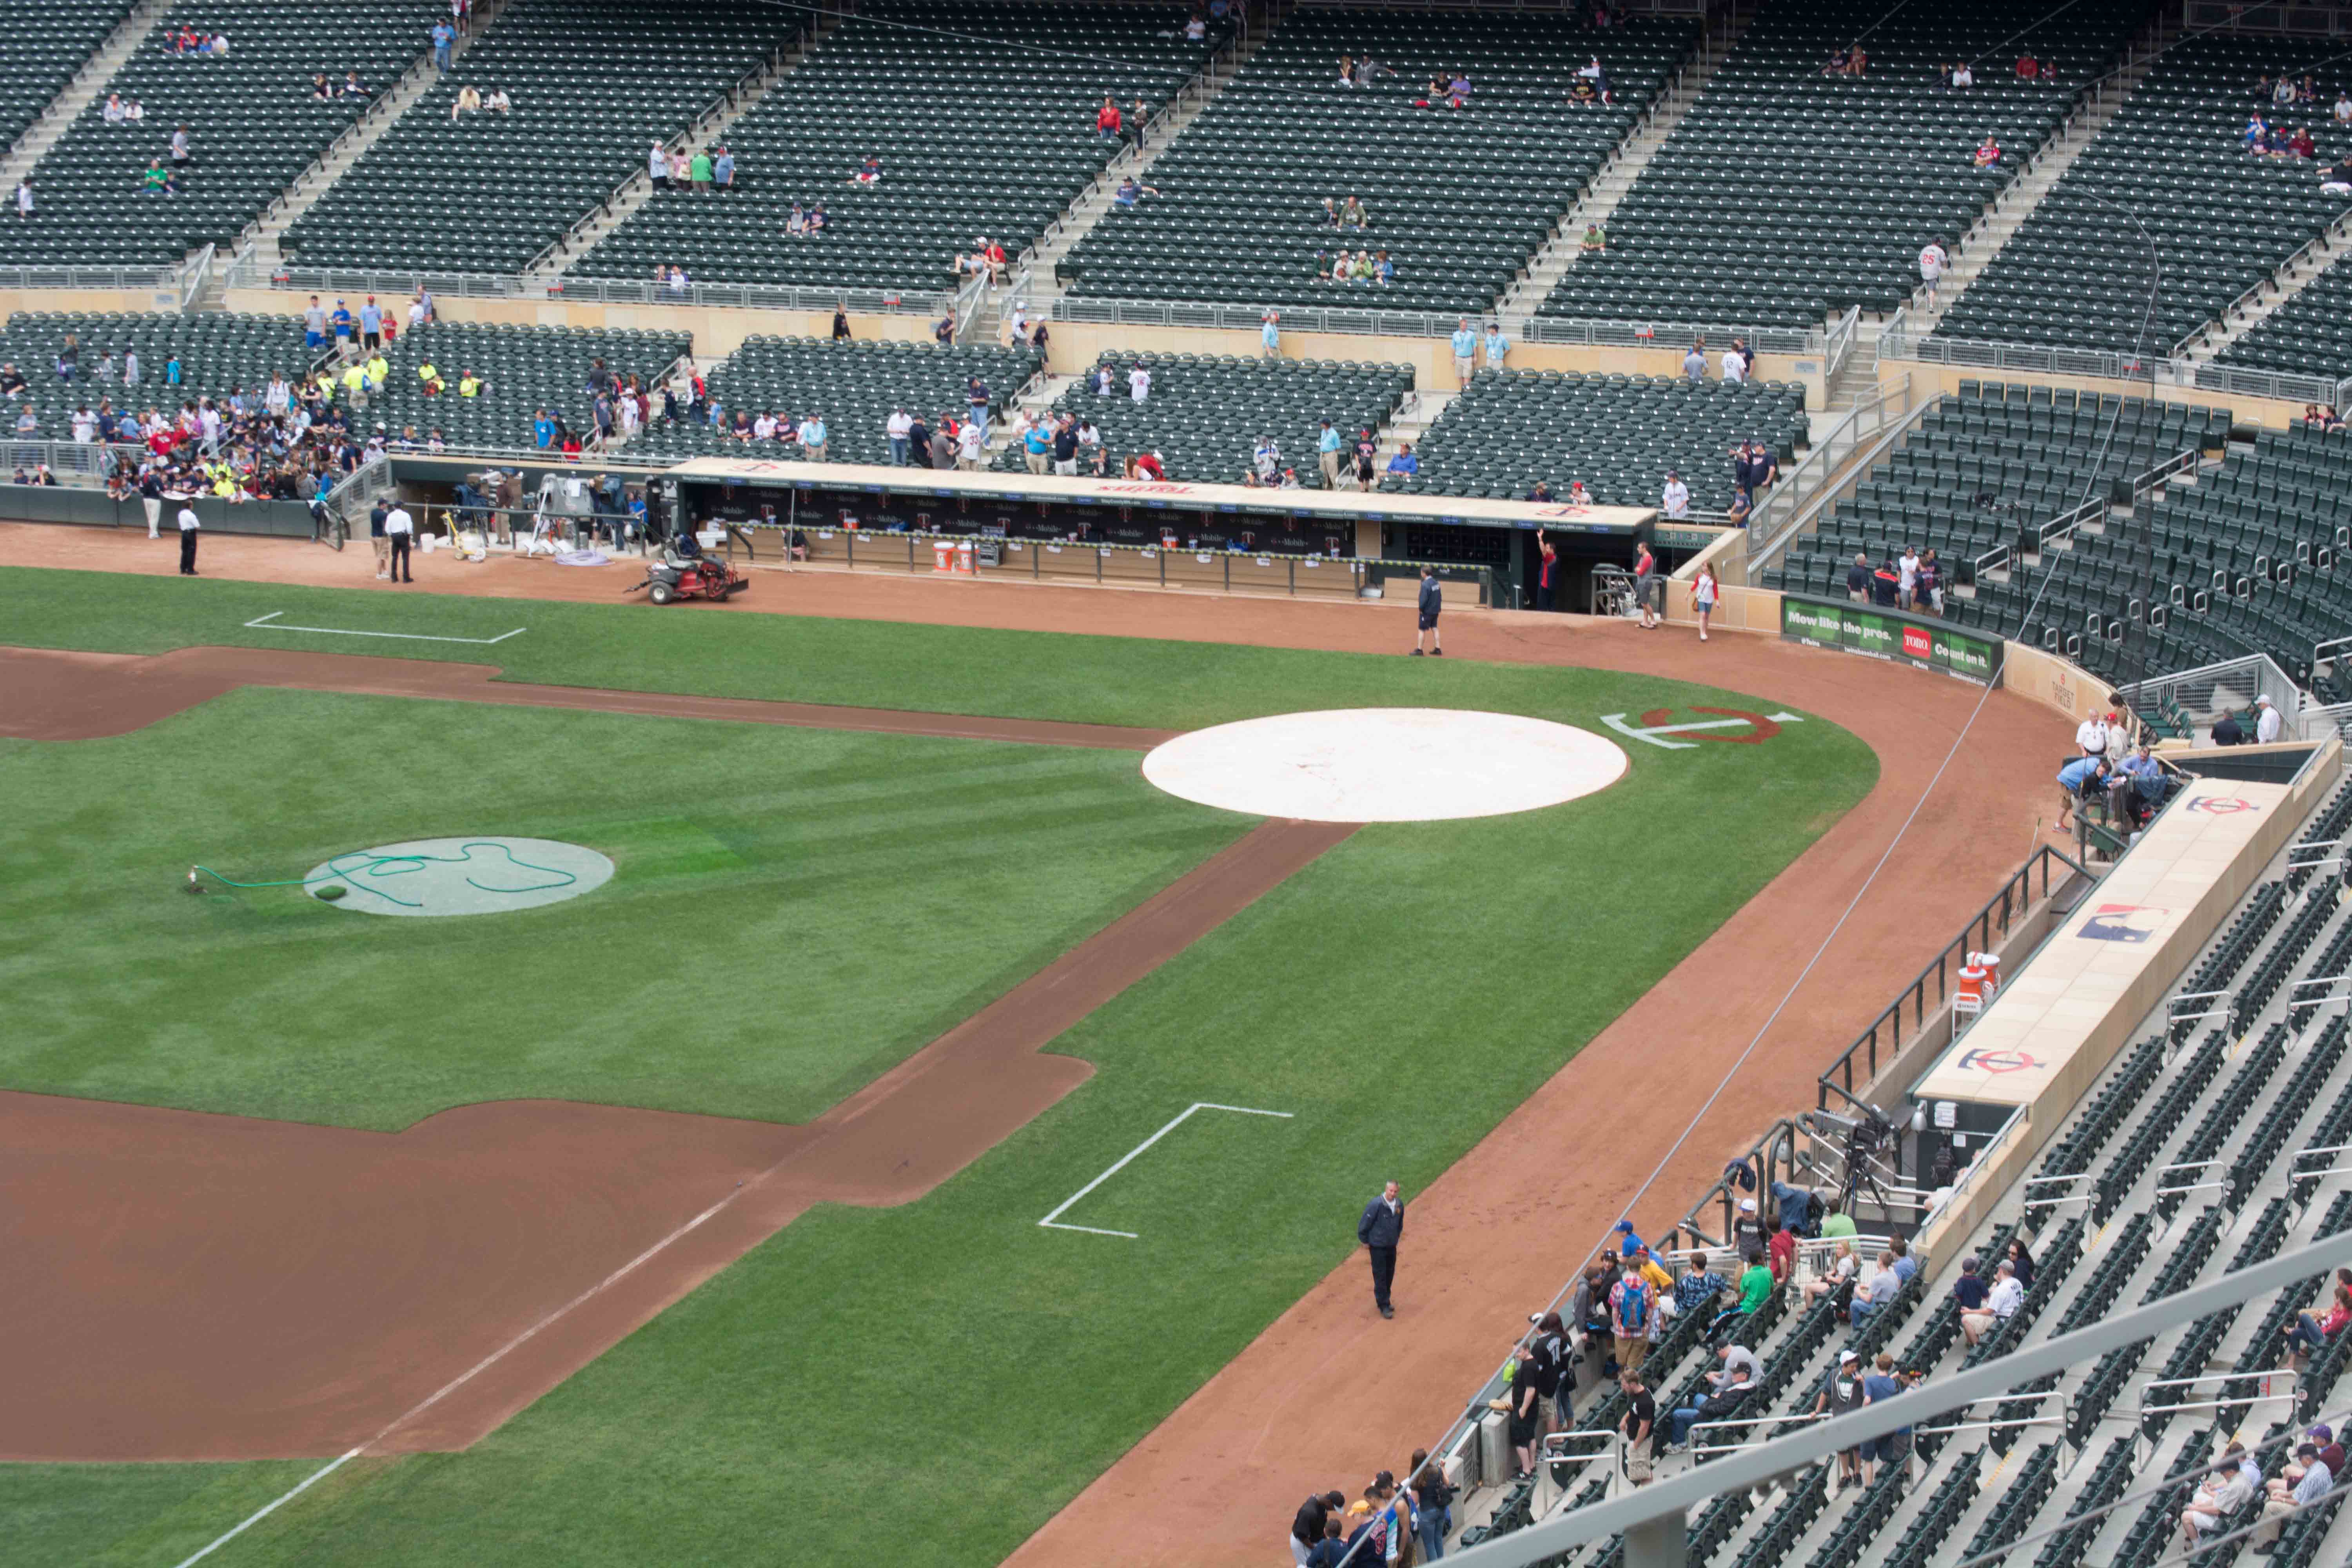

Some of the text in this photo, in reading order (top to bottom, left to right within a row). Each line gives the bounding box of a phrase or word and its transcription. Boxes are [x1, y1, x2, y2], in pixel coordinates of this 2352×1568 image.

[1922, 254, 1934, 265] 25
[1788, 611, 1891, 641] Mow like the pros.
[1904, 635, 1928, 651] TORO
[1844, 646, 1891, 661] twinsbaseball.com
[1935, 643, 1987, 668] Count on it.
[2051, 681, 2075, 701] TARGET
[2054, 693, 2071, 709] FIELD
